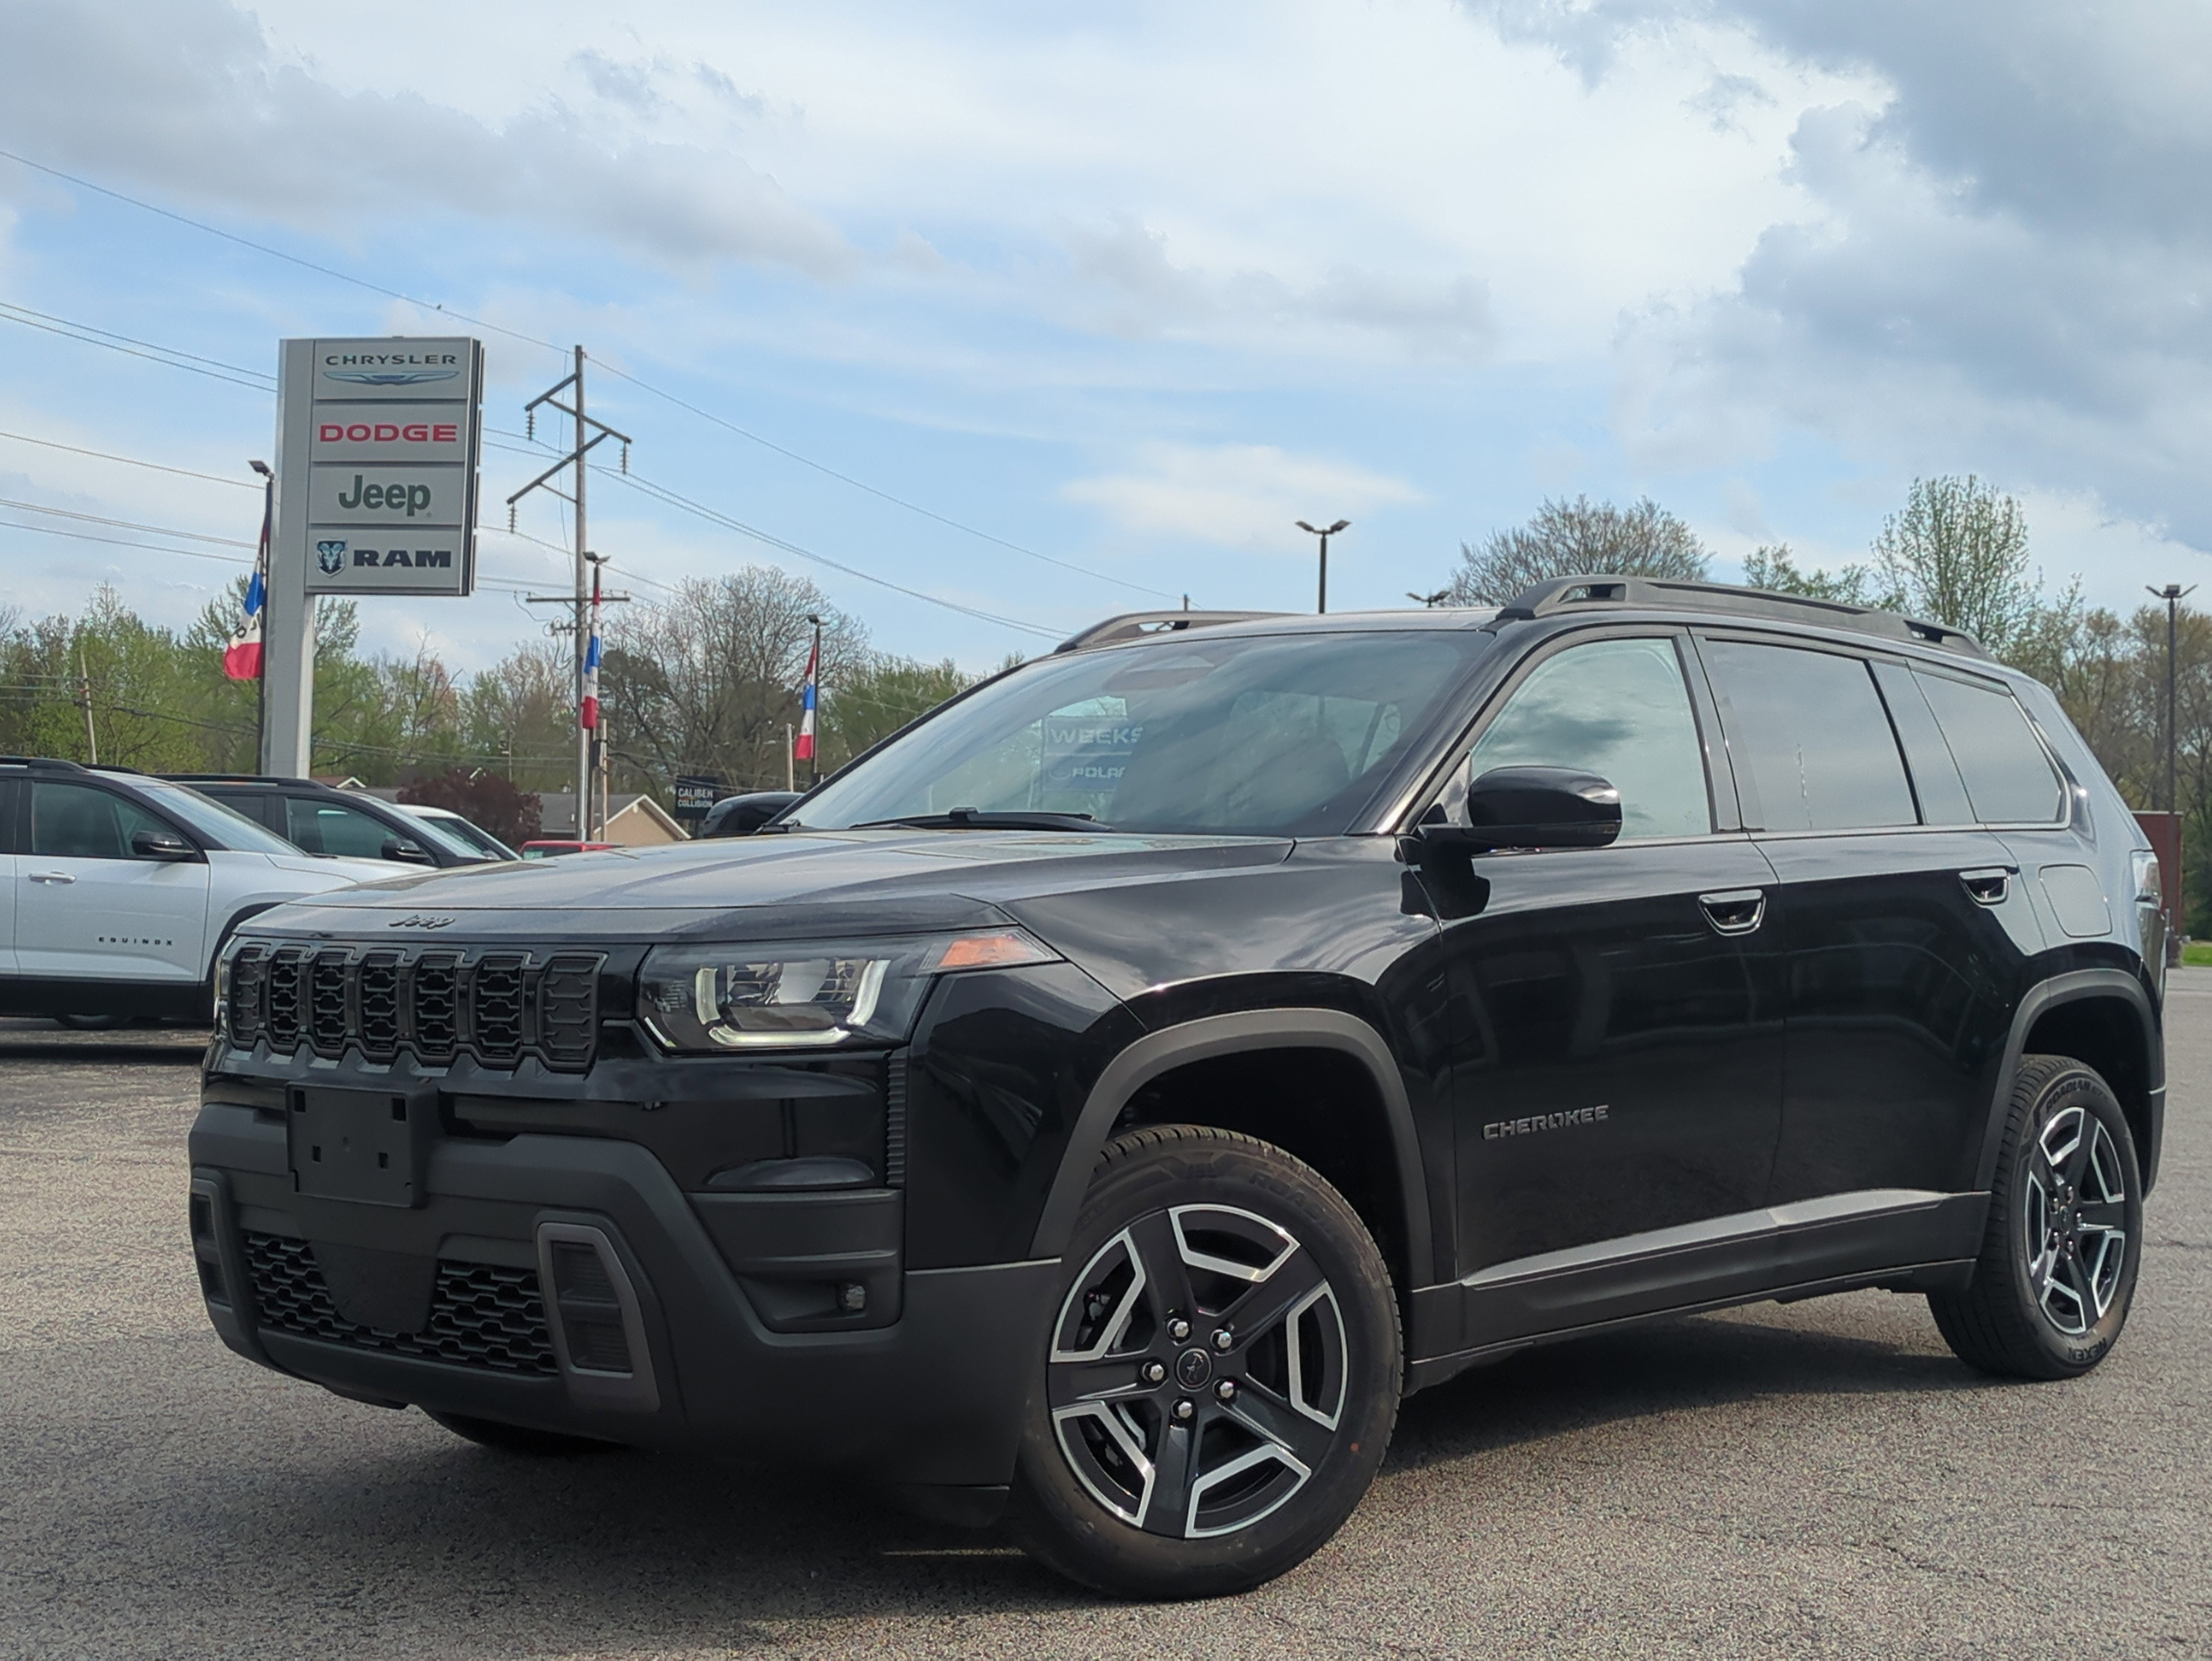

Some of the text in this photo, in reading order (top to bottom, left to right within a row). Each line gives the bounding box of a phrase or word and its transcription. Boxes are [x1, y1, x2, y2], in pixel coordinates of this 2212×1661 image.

[325, 354, 456, 365] CHRYSLER
[320, 424, 457, 442] DODGE
[338, 475, 431, 517] Jeep
[353, 550, 451, 567] RAM
[1051, 727, 1143, 744] WEEKS
[99, 937, 172, 946] EQUINOX
[1483, 1104, 1609, 1141] CHEROKEE
[2067, 1337, 2107, 1362] NEXEN
